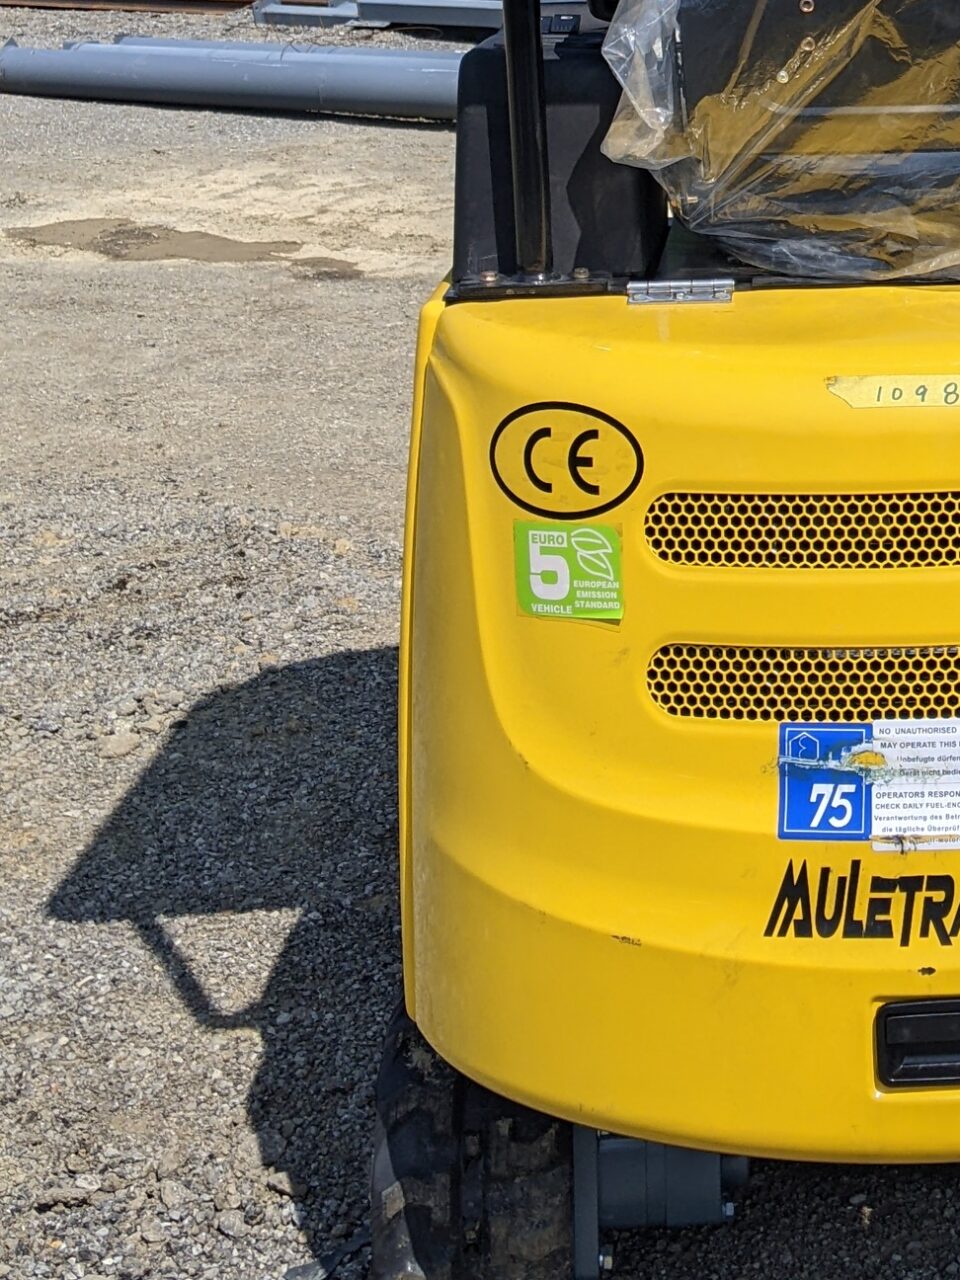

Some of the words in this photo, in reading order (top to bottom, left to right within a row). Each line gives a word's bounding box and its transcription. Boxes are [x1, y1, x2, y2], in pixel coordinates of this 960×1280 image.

[524, 426, 600, 496] CE
[531, 533, 565, 546] EURO
[528, 530, 570, 600] 5
[573, 580, 620, 589] EUROPEAN
[576, 590, 618, 599] EMISSION
[530, 603, 573, 614] VEHICLE
[574, 600, 620, 609] STANDARD
[875, 791, 925, 799] OPERATORS
[808, 783, 858, 828] 75
